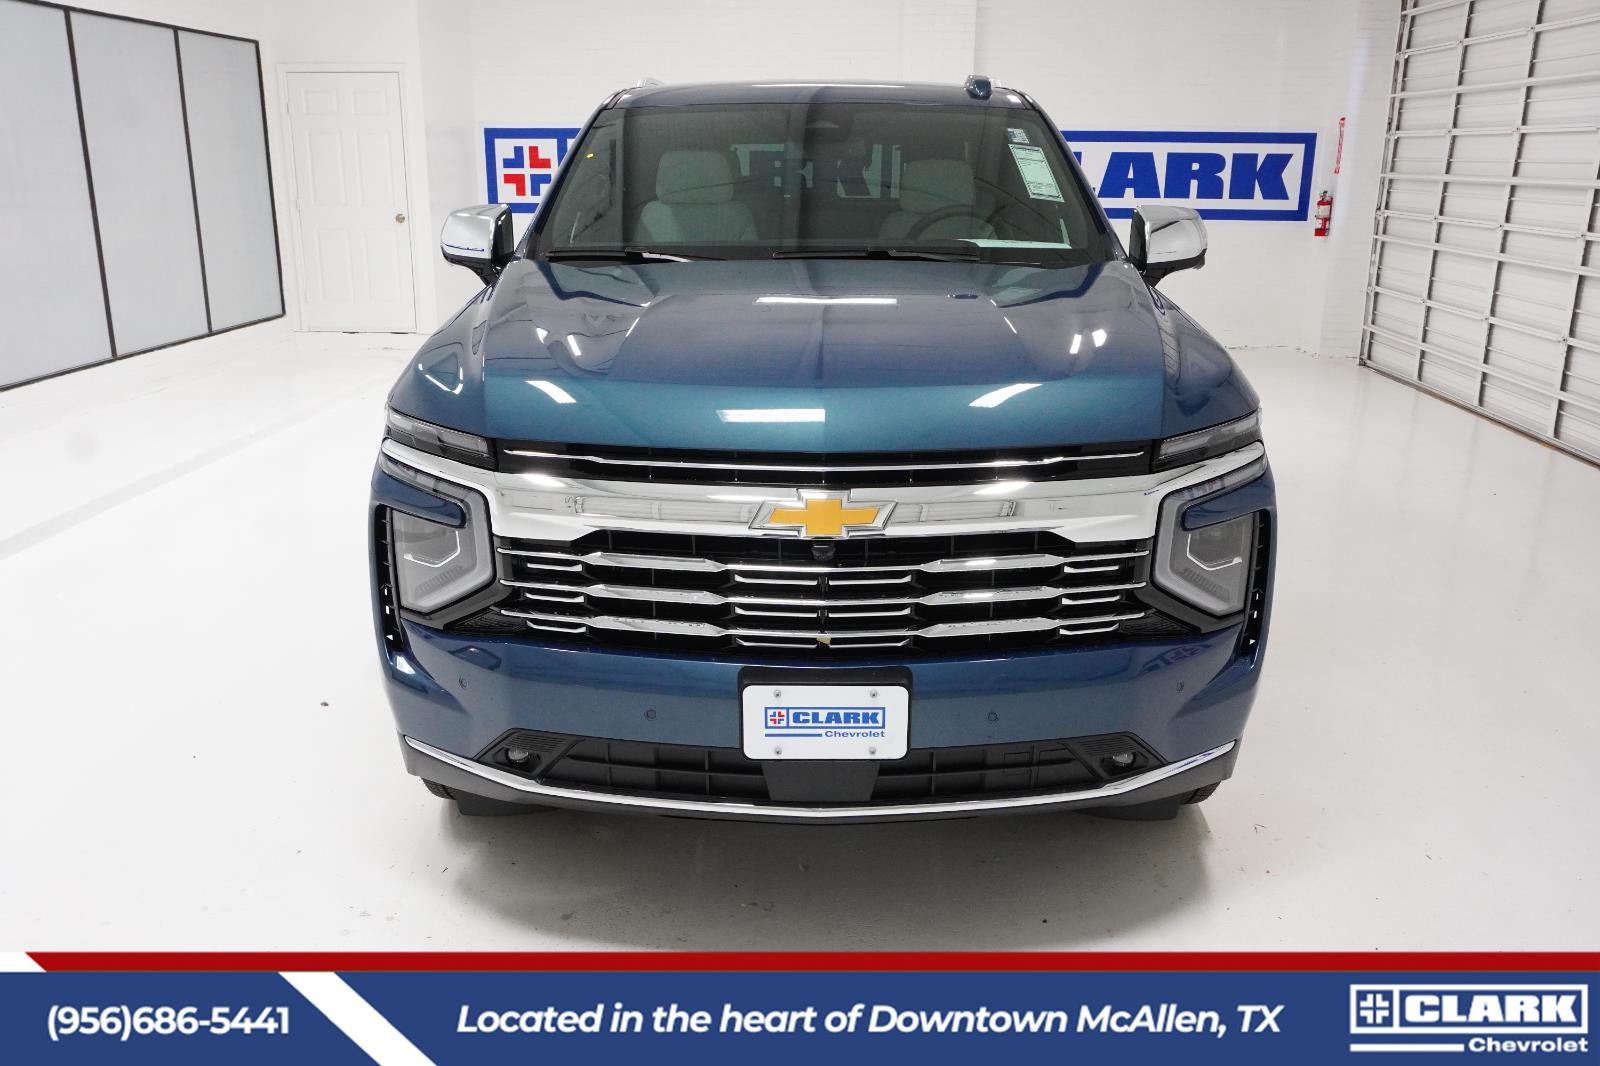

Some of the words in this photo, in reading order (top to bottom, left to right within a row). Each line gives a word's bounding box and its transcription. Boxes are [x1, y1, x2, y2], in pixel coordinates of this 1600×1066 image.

[1073, 151, 1294, 200] ARK
[792, 711, 879, 724] CLARK
[824, 730, 885, 738] Chevrolet
